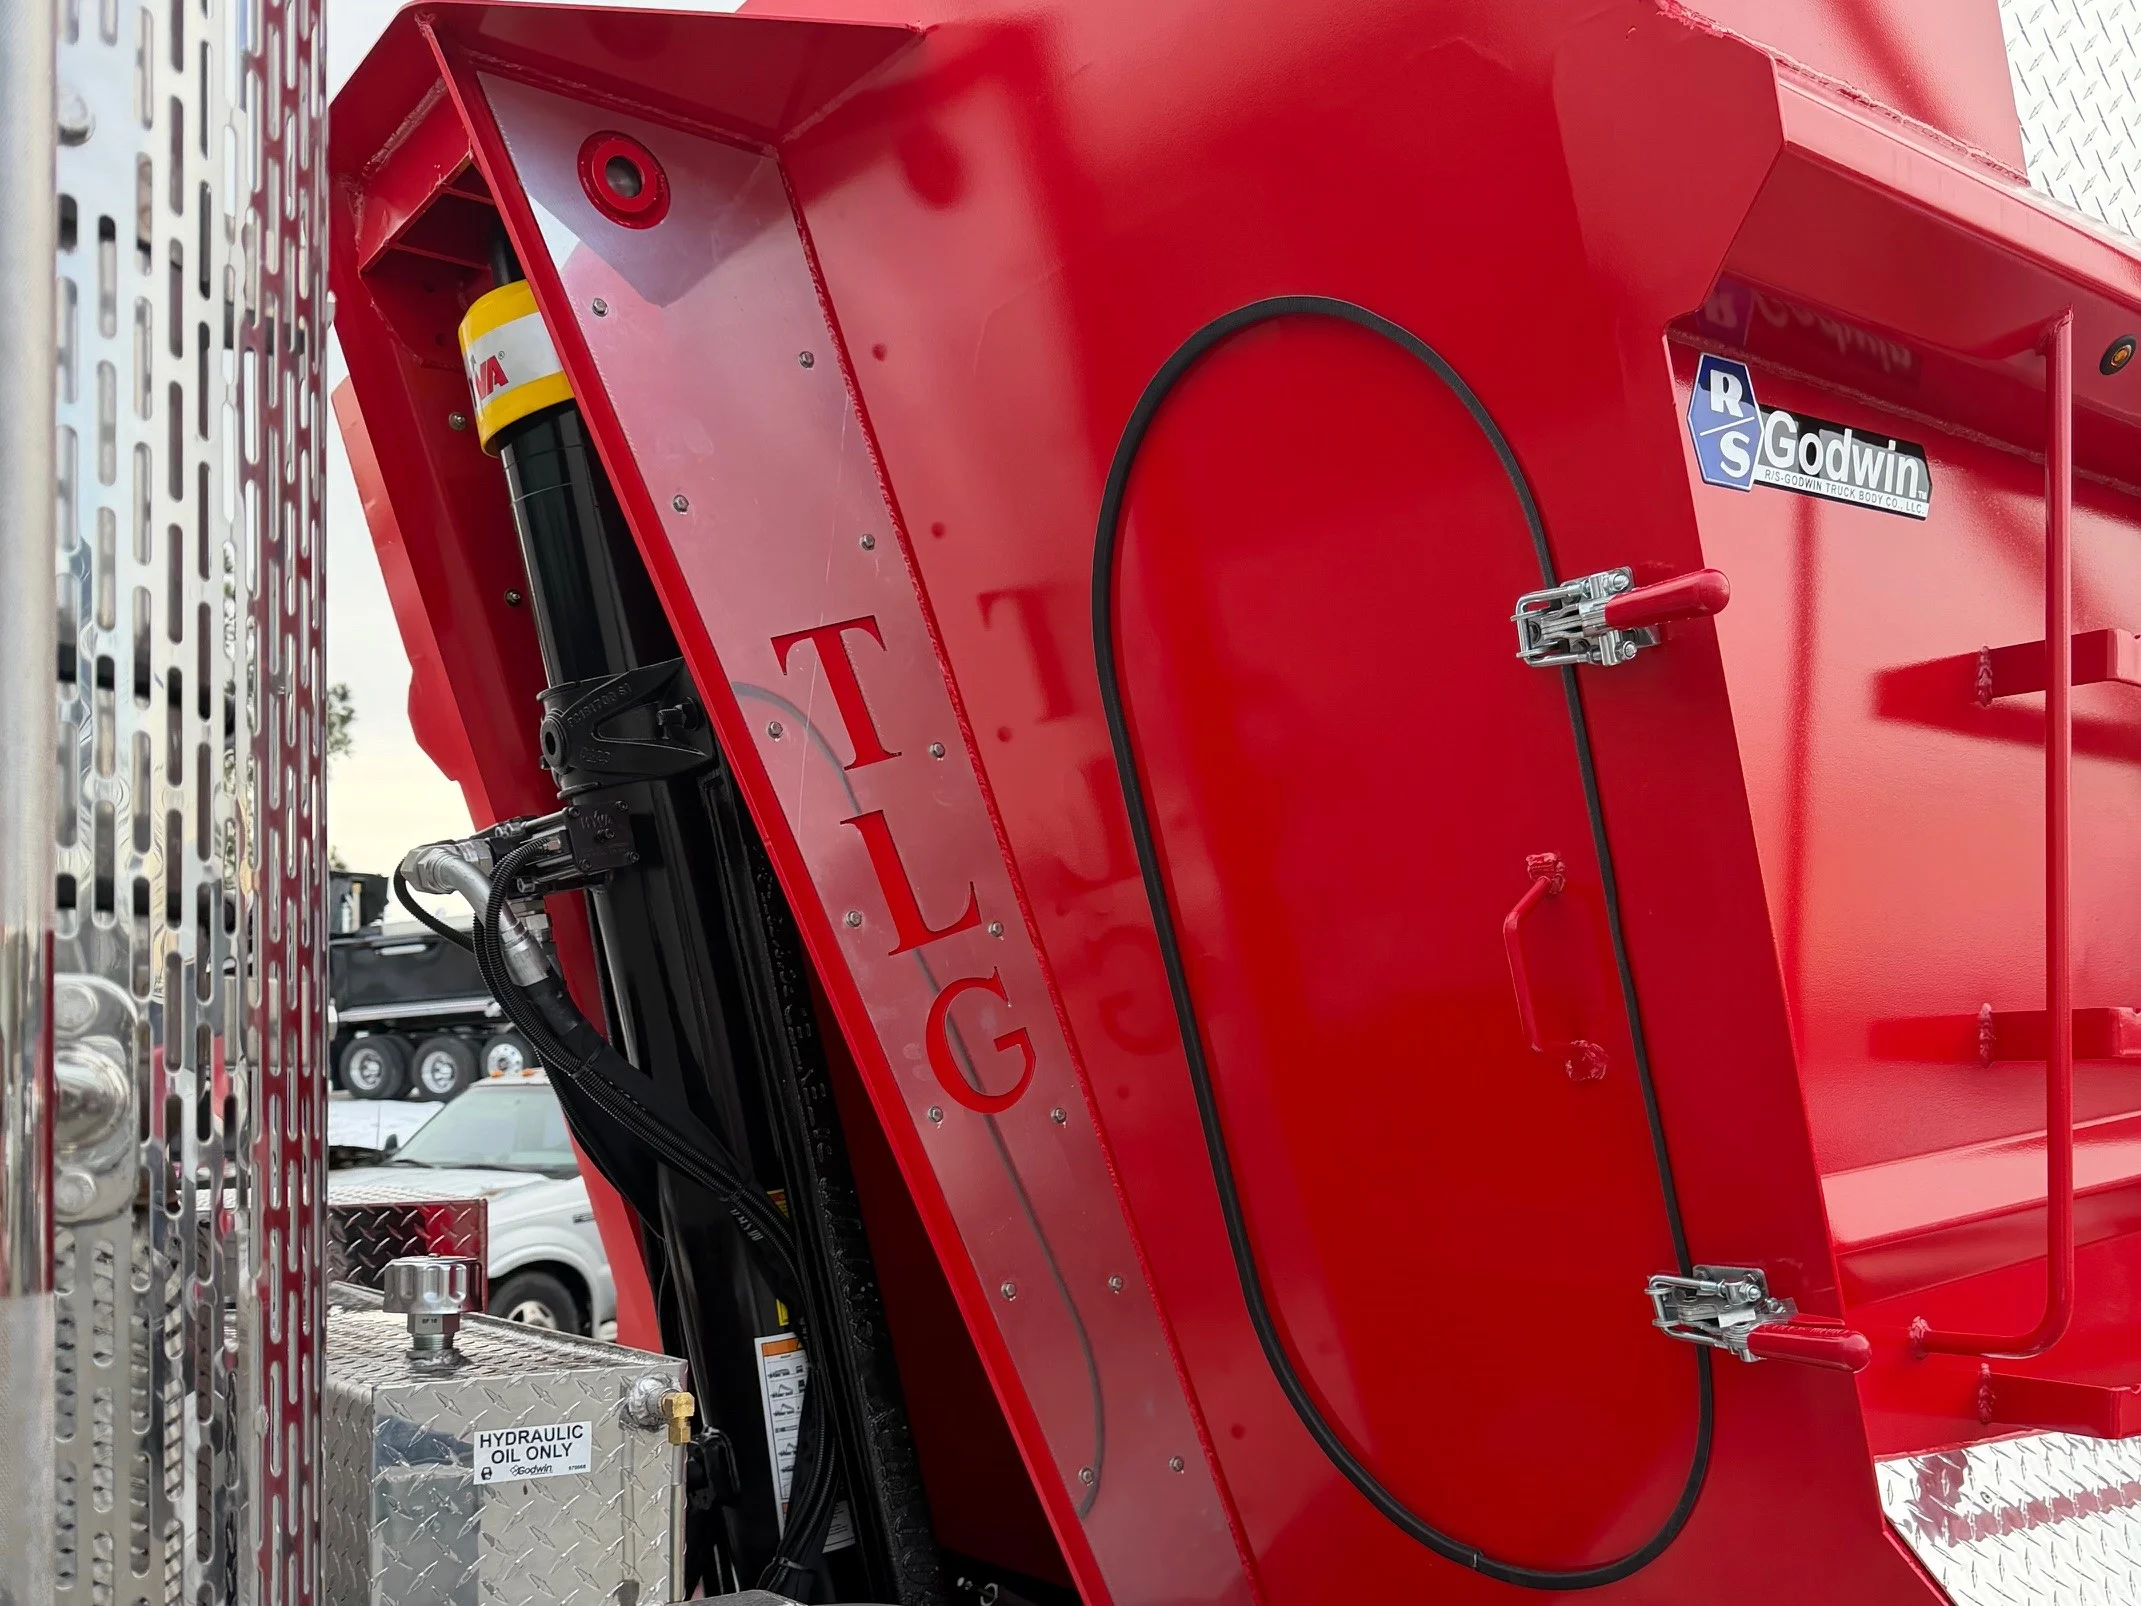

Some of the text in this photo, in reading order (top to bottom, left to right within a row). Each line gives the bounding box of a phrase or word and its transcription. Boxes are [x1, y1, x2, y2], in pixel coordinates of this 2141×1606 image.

[1764, 410, 1920, 499] Godwin
[1764, 469, 1823, 492] R/S-GODWIN
[1826, 484, 1855, 499] TRUCK
[1859, 491, 1884, 504] BODY
[480, 1425, 583, 1448] HYDRAULIC
[491, 1442, 573, 1464] OIL ONLY
[517, 1463, 554, 1475] Godwin
